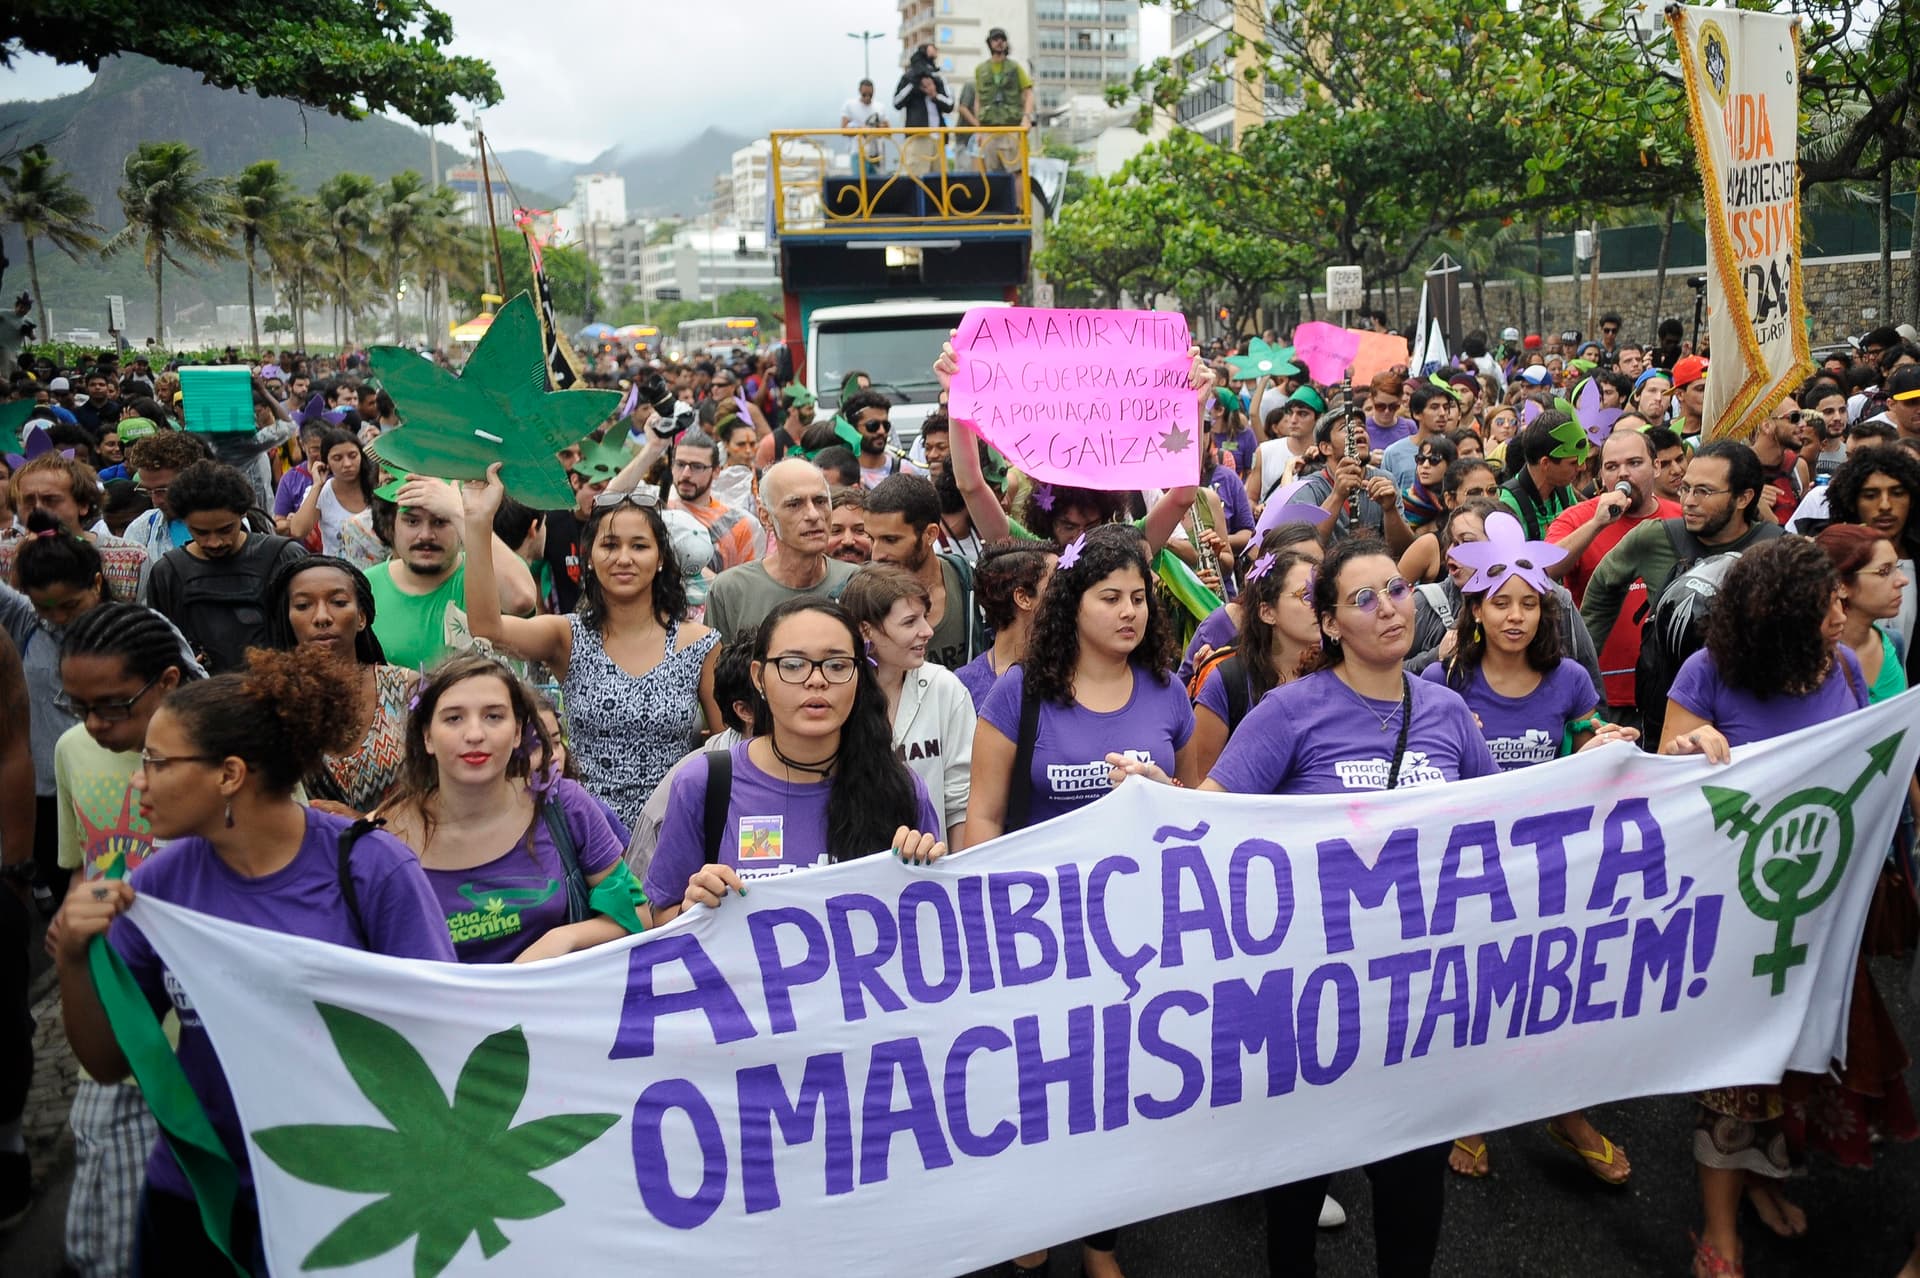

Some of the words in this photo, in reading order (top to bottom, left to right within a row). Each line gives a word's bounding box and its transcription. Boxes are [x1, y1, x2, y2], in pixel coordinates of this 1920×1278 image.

[970, 318, 998, 352] A
[970, 359, 1013, 393] DA
[1021, 361, 1119, 393] GUERRA
[1124, 366, 1148, 387] AS
[1153, 368, 1191, 389] DROGA
[991, 405, 1006, 428] A
[1120, 398, 1184, 422] POBRE
[1014, 429, 1164, 470] EGALIZA
[1341, 763, 1390, 776] march
[609, 934, 757, 1060] A
[747, 822, 1295, 1033] PROIBIÇÃO
[1317, 798, 1694, 954] MATA,
[632, 1078, 728, 1230] O
[736, 963, 1360, 1214] MACHISMO
[1369, 894, 1724, 1066] TAMBÉM!
